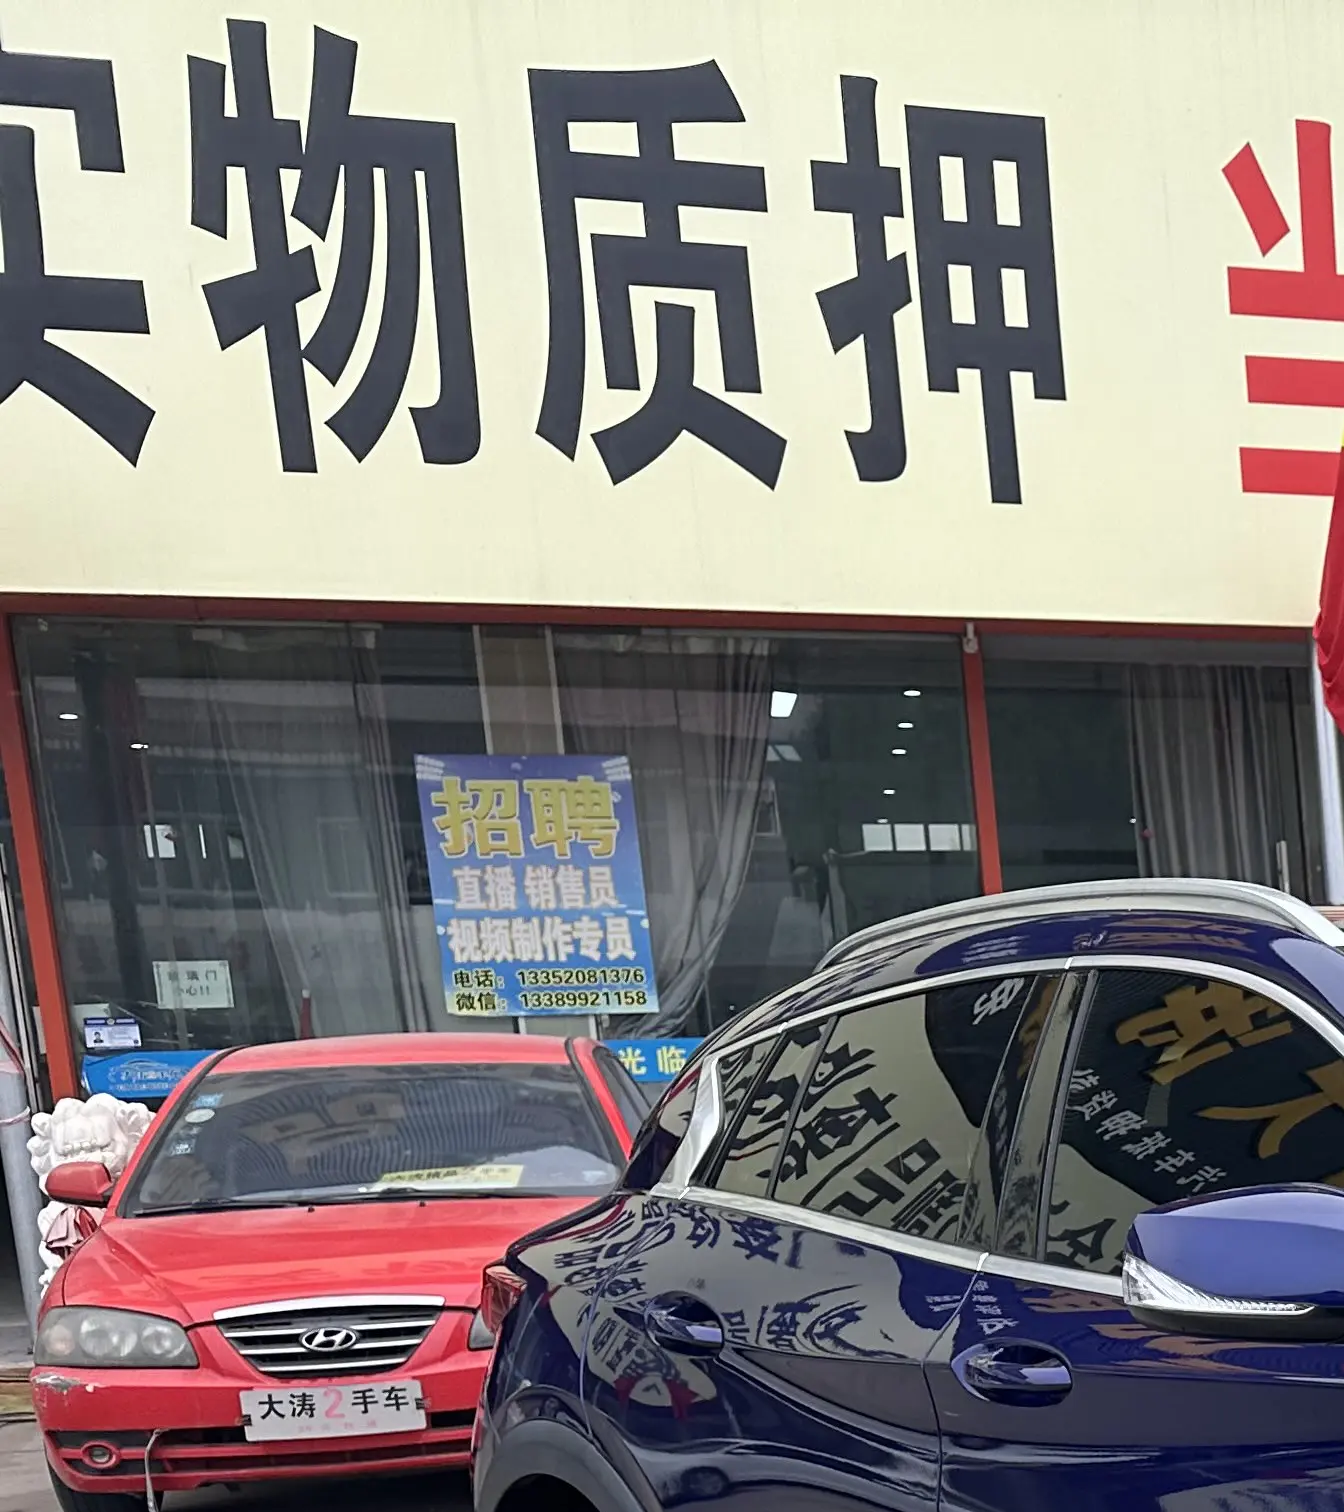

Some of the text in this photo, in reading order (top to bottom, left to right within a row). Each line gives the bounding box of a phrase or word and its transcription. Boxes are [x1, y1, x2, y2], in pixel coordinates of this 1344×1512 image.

[431, 776, 620, 859] 招聘
[452, 864, 621, 911] 直播 销售员
[448, 916, 637, 962] 视频制作专员
[516, 968, 645, 987] 13352081376
[518, 990, 648, 1010] 13389921158
[257, 1386, 410, 1420] 大涛2手车
